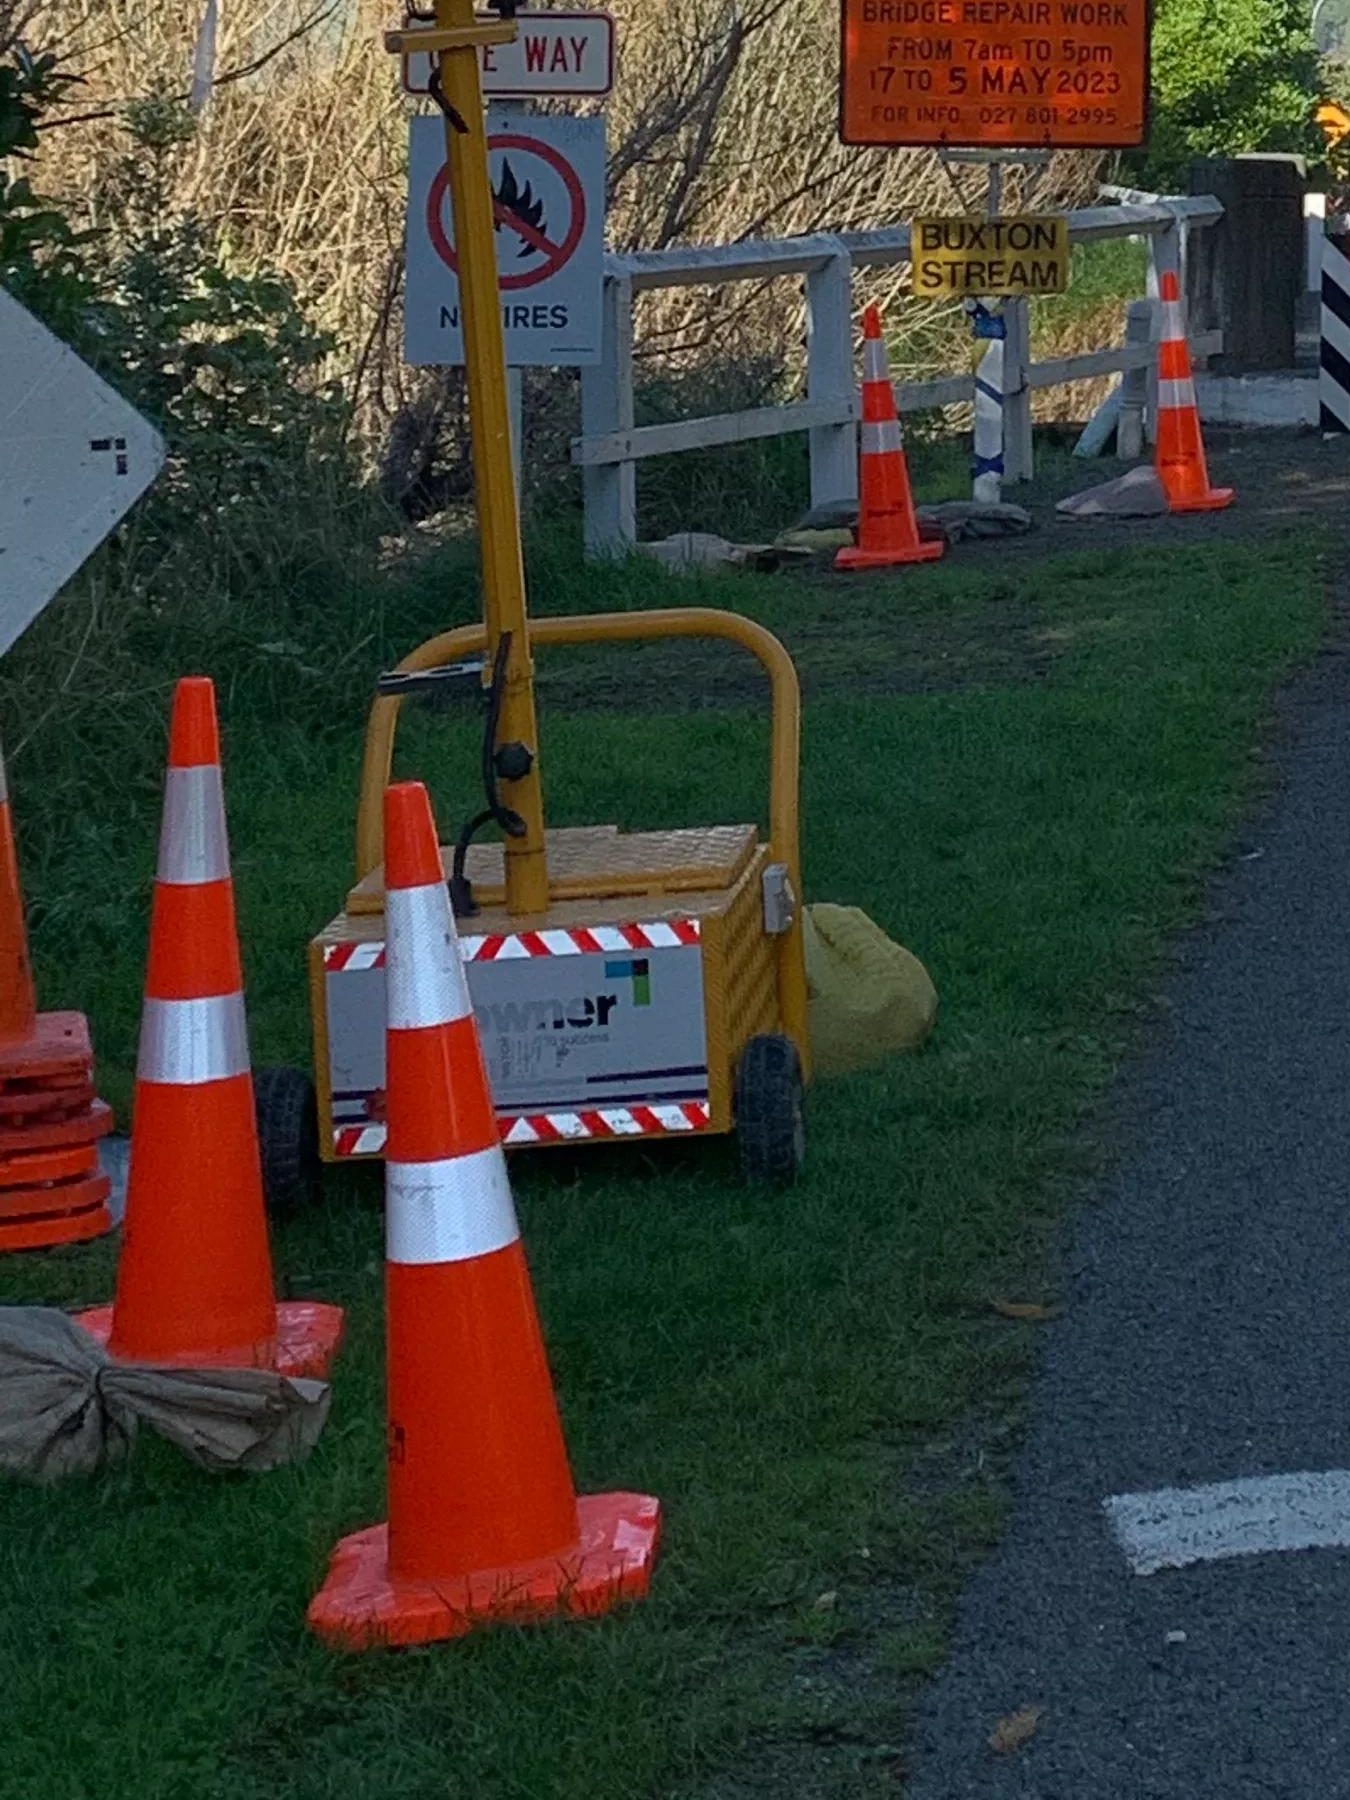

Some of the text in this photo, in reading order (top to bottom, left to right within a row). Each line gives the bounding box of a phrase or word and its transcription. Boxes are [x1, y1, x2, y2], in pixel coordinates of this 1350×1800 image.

[963, 2, 1049, 25] REPAIR
[1061, 4, 1128, 26] WORK
[525, 36, 588, 72] WAY
[888, 37, 1112, 64] FROM 7am TO 5pm
[870, 67, 1121, 94] 17 TO 5 MAY 2023
[871, 106, 908, 123] FOR
[980, 107, 1016, 124] 027
[1026, 108, 1058, 124] 801
[1067, 108, 1117, 125] 2995
[920, 222, 1057, 250] BUXTON
[921, 260, 1058, 288] STREAM
[504, 305, 568, 328] IRES
